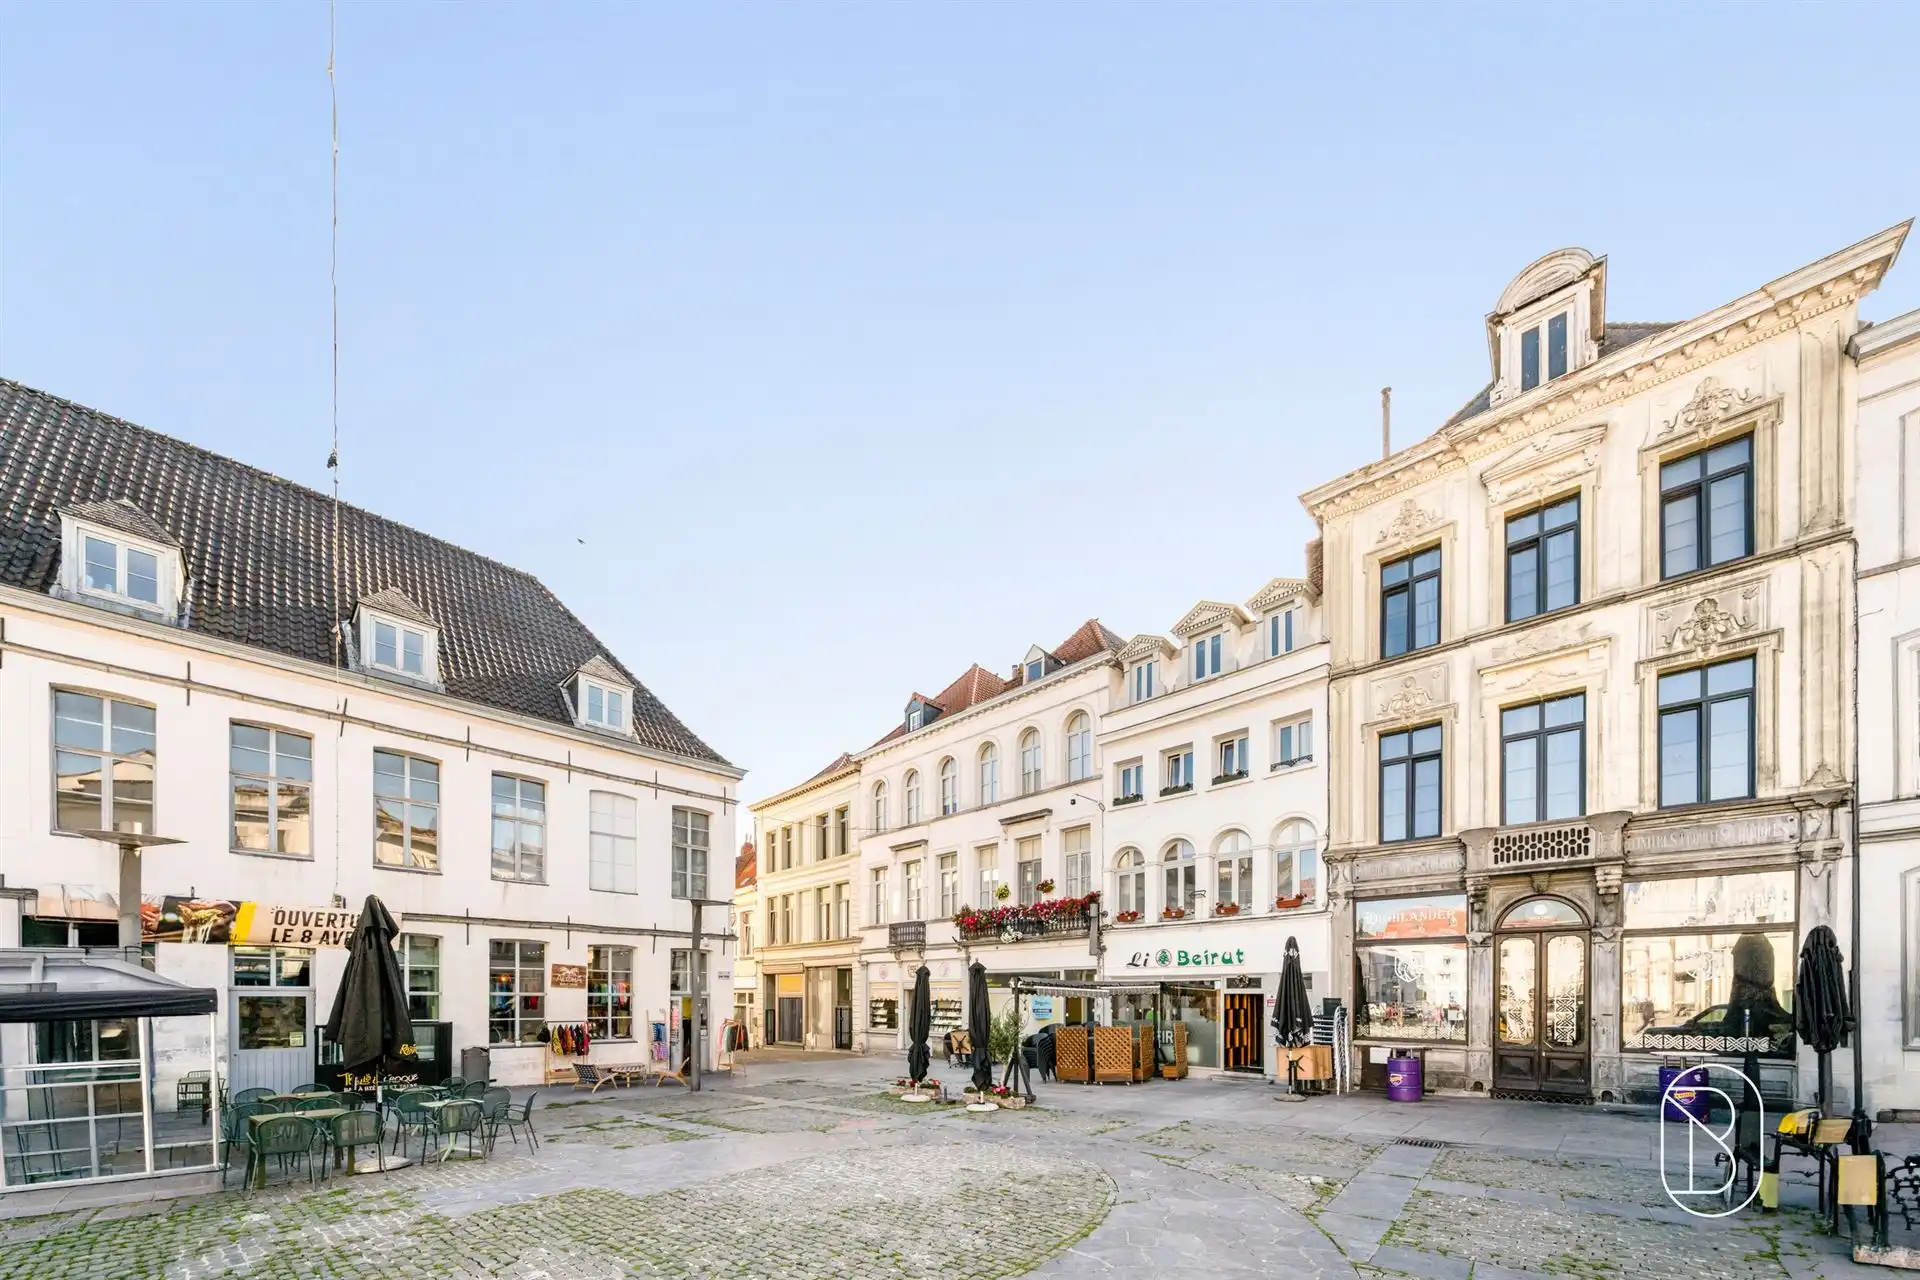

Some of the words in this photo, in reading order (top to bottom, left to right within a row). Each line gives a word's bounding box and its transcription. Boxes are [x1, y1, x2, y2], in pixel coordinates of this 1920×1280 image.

[274, 909, 360, 929] OUVERTU
[270, 928, 294, 943] LE
[300, 929, 312, 943] 8
[1126, 952, 1149, 967] Li
[1177, 948, 1244, 966] Beirut
